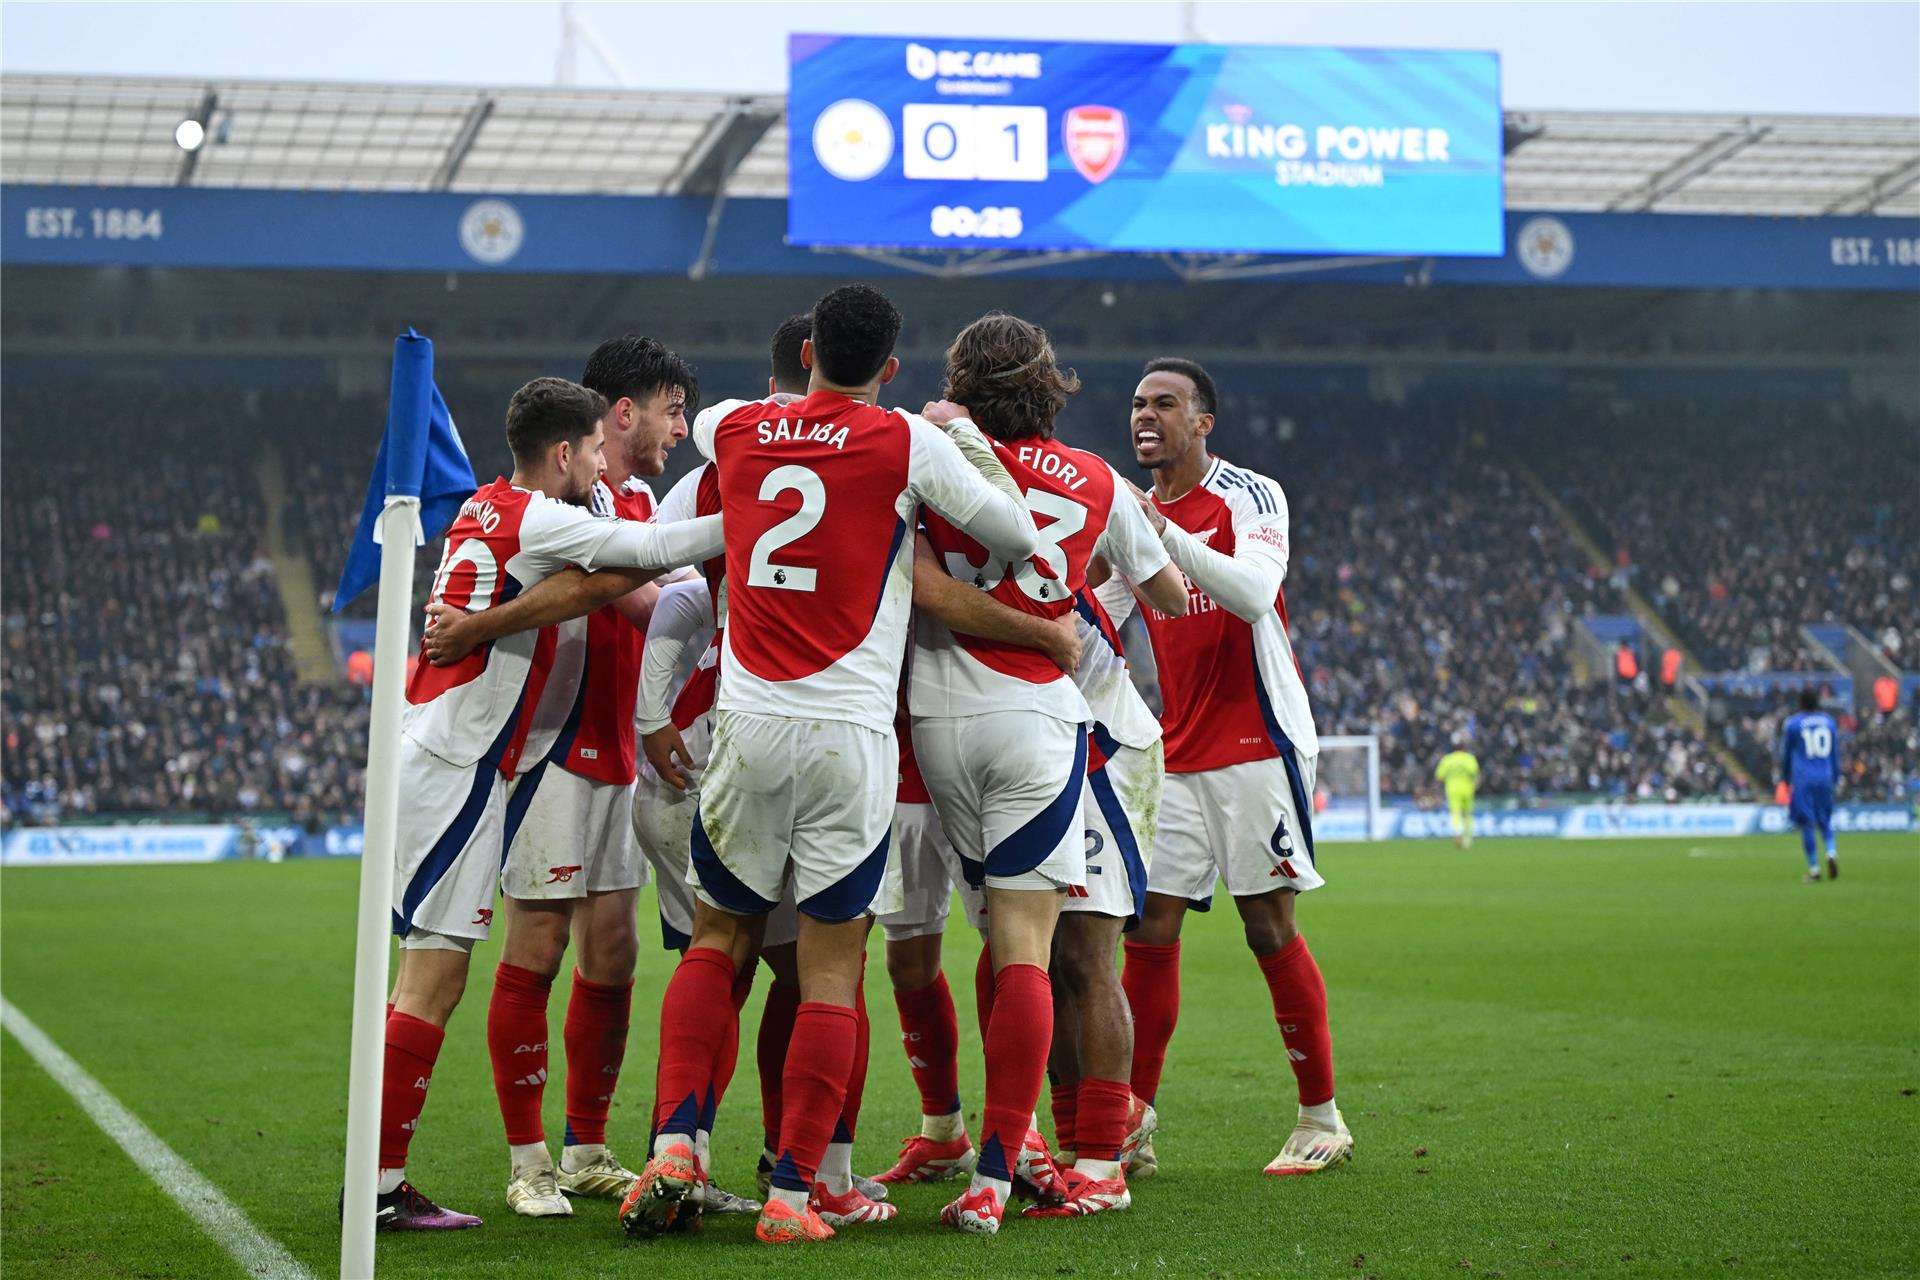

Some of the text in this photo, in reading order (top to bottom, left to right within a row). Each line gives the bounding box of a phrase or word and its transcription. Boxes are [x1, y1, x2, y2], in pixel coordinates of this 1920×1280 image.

[923, 121, 1019, 162] 0 1
[1206, 122, 1450, 162] KING POWER
[1275, 160, 1384, 187] STADIUM
[26, 206, 163, 241] EST. 1884
[1831, 236, 1880, 267] EST.
[757, 418, 850, 450] SALIBA
[747, 464, 827, 592] 2
[1260, 526, 1284, 541] VISIT
[1801, 728, 1833, 759] 10
[1270, 813, 1295, 858] 6
